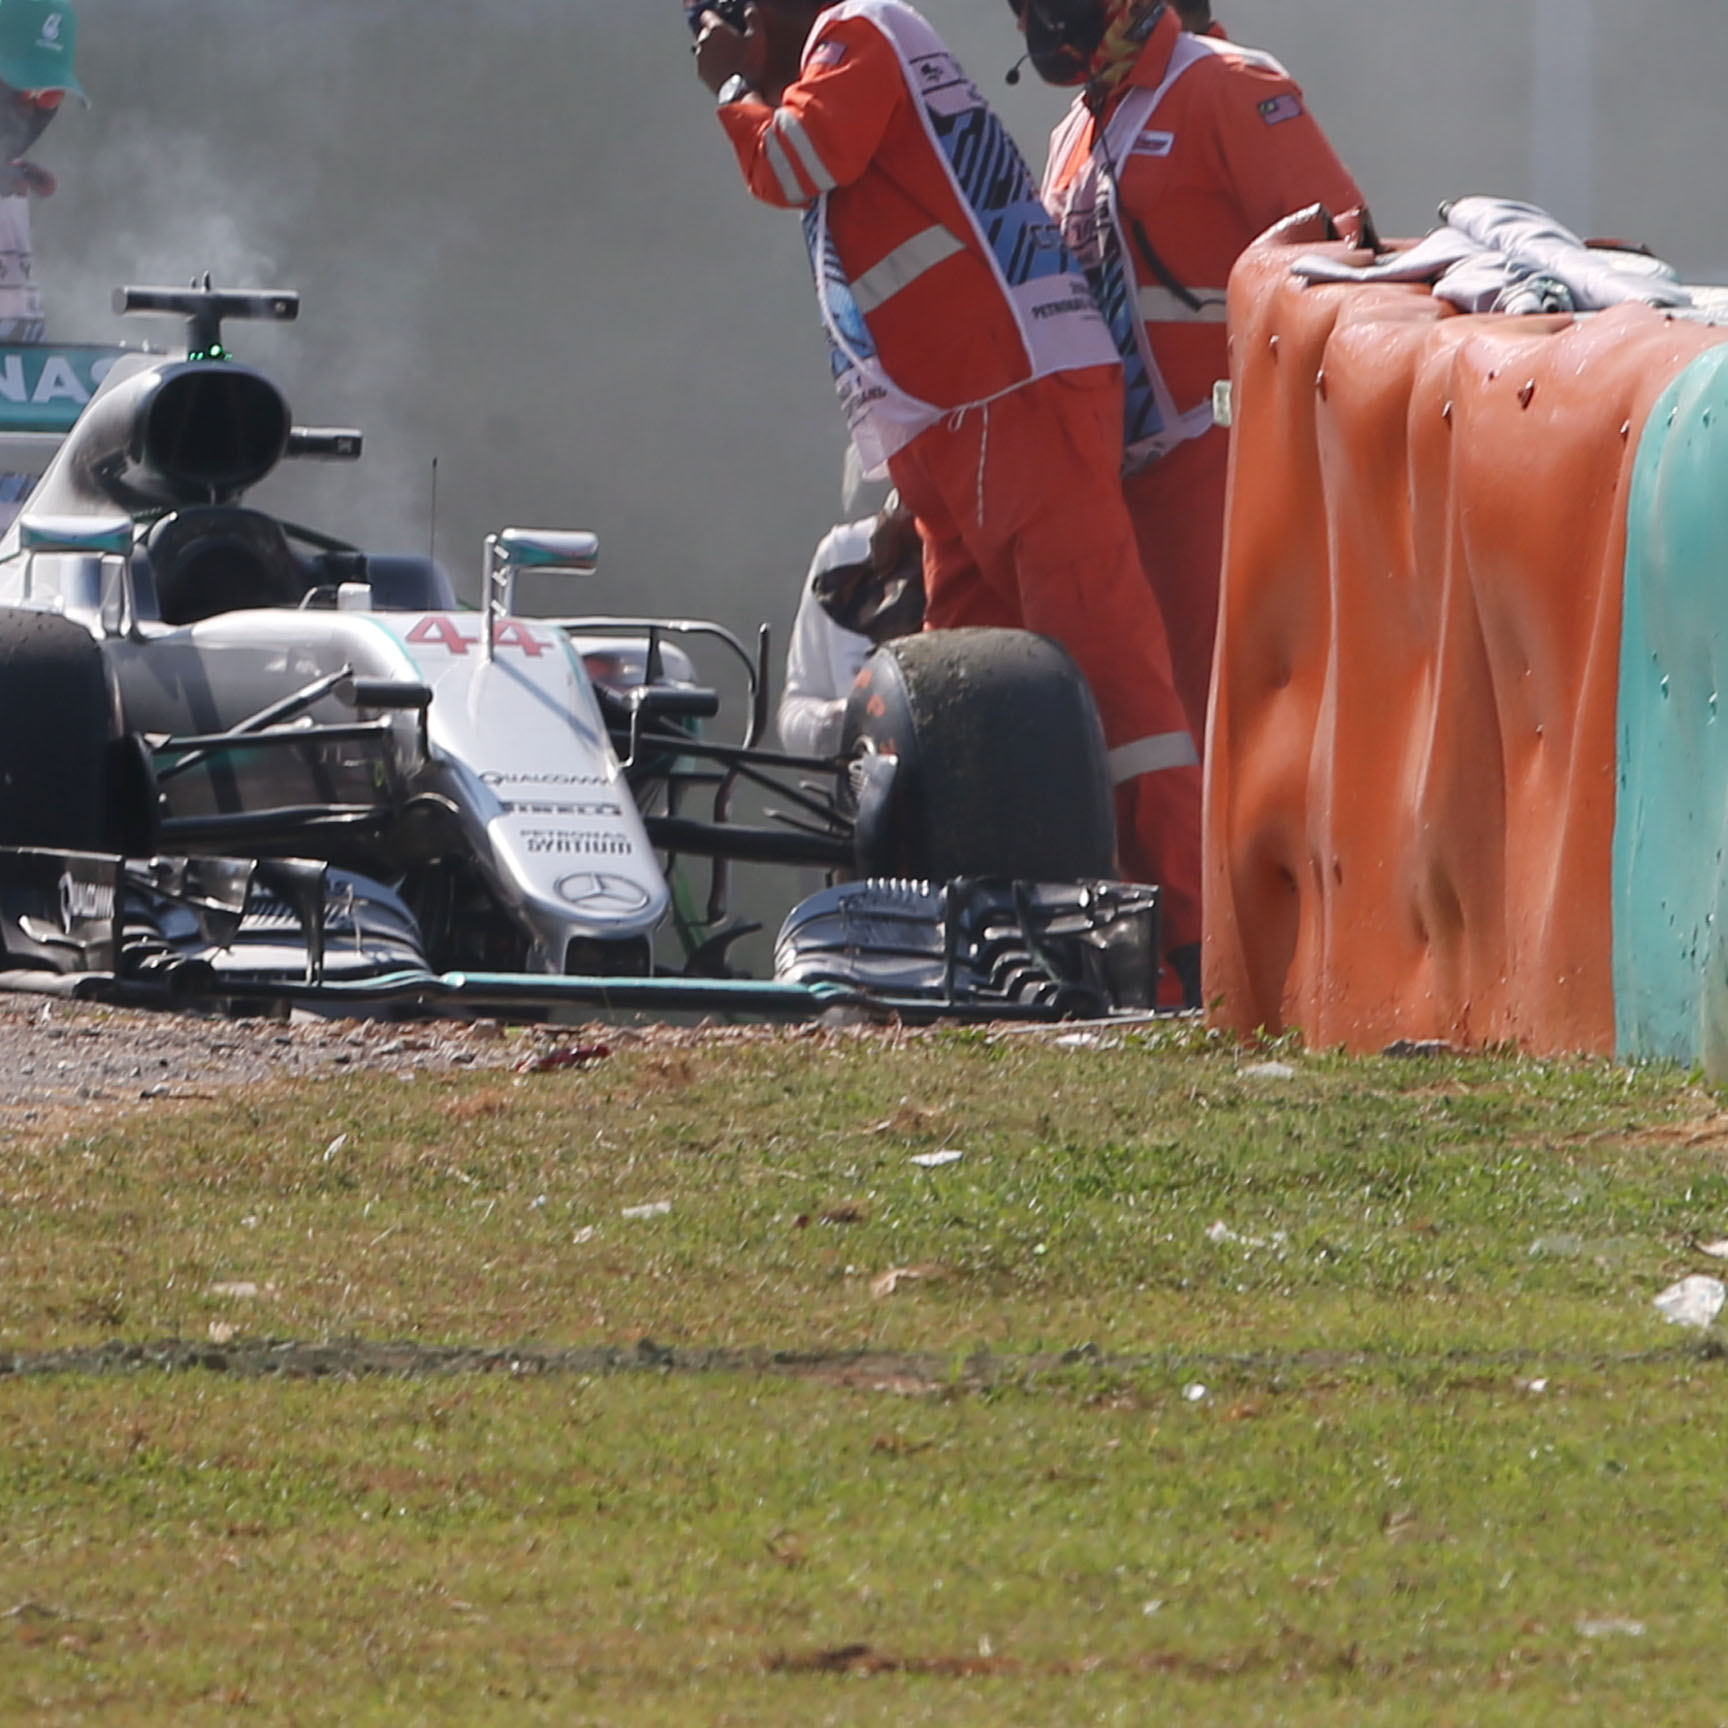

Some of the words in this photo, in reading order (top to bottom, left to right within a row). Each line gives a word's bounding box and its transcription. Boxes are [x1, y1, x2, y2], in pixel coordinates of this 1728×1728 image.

[404, 615, 554, 657] 44
[478, 771, 612, 786] QUALCOMM
[520, 829, 628, 839] PETRONAS
